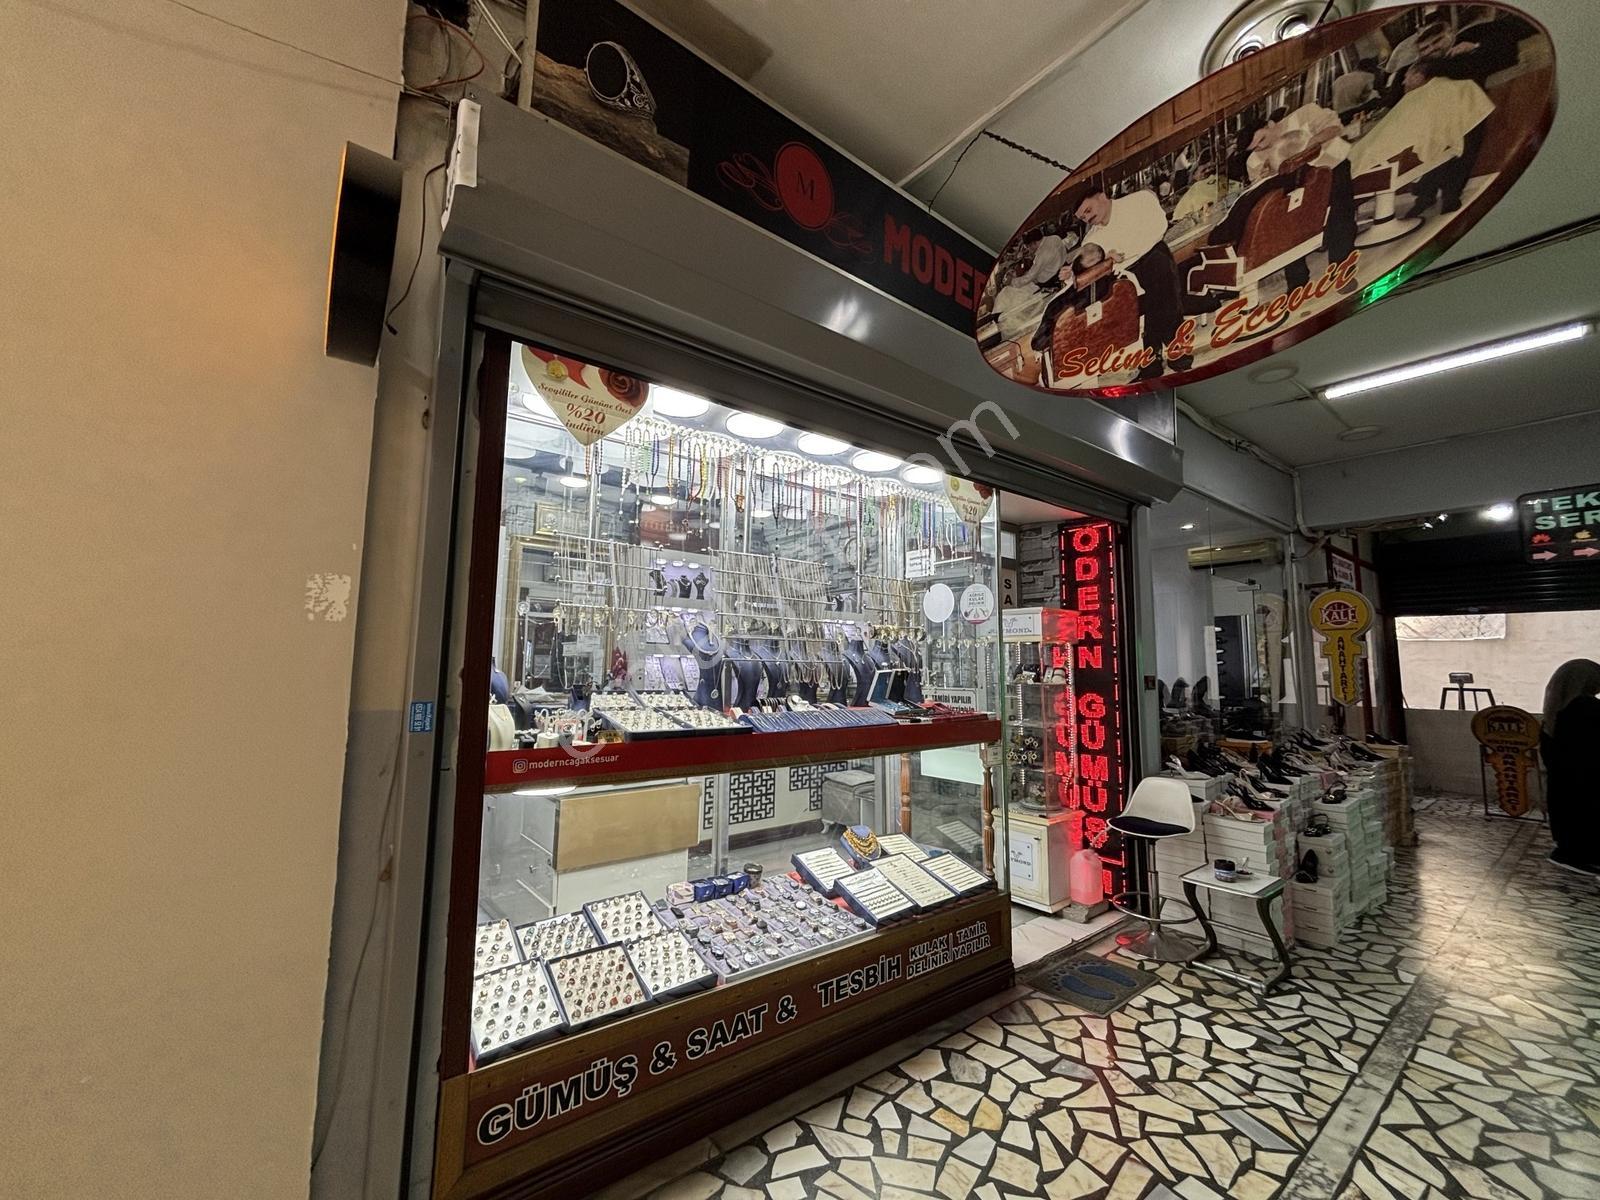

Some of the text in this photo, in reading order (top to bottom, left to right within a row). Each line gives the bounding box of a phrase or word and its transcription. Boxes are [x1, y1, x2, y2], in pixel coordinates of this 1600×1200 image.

[1058, 249, 1362, 379] Selim & Ecevit
[566, 402, 606, 425] %20
[1320, 607, 1358, 623] KALE
[529, 755, 620, 768] moderncagaksesuar
[956, 921, 987, 943] TAMİR
[909, 934, 948, 962] KULAK
[953, 935, 991, 960] YAPILIR
[477, 954, 902, 1146] GÜMÜŞ & SAAT & TESBİH
